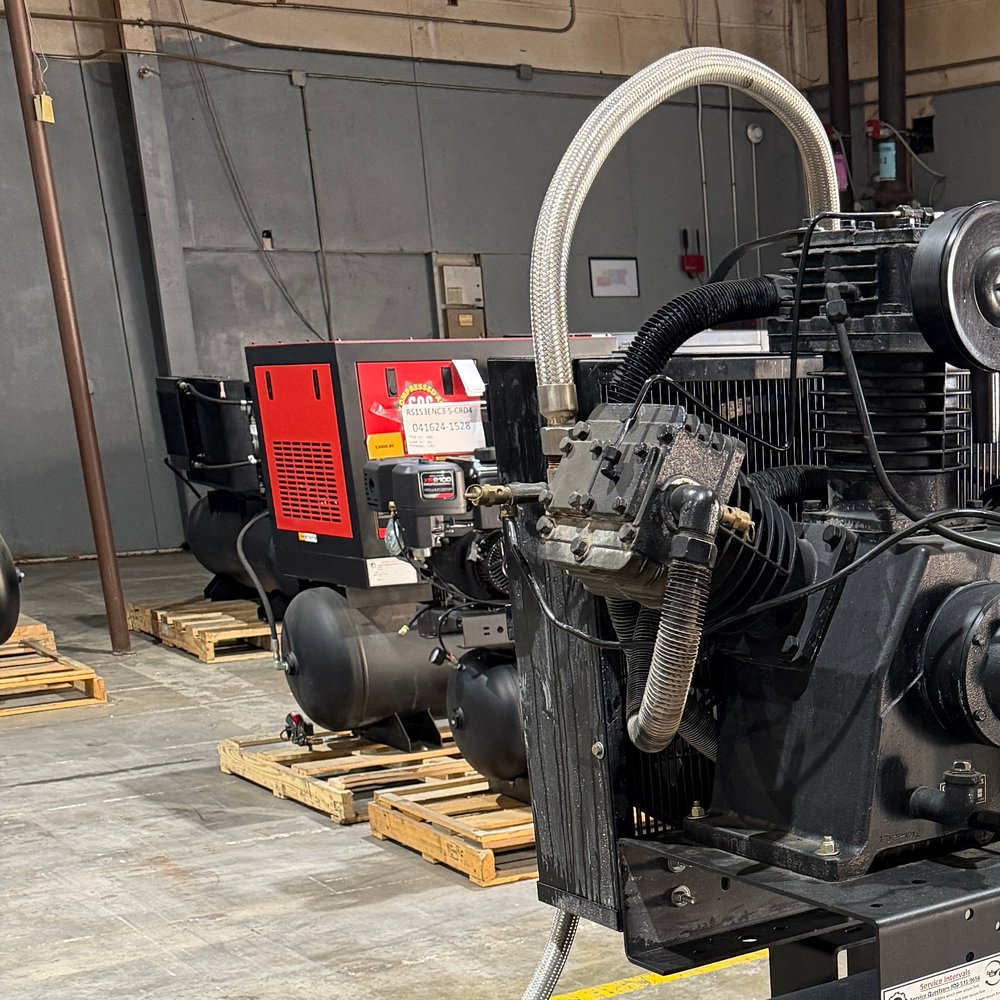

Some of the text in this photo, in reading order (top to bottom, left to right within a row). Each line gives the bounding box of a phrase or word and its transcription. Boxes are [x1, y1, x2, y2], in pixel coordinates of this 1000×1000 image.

[398, 383, 437, 406] OMPRESSED
[412, 422, 472, 433] 041624-1528
[920, 969, 971, 991] Service Intervals
